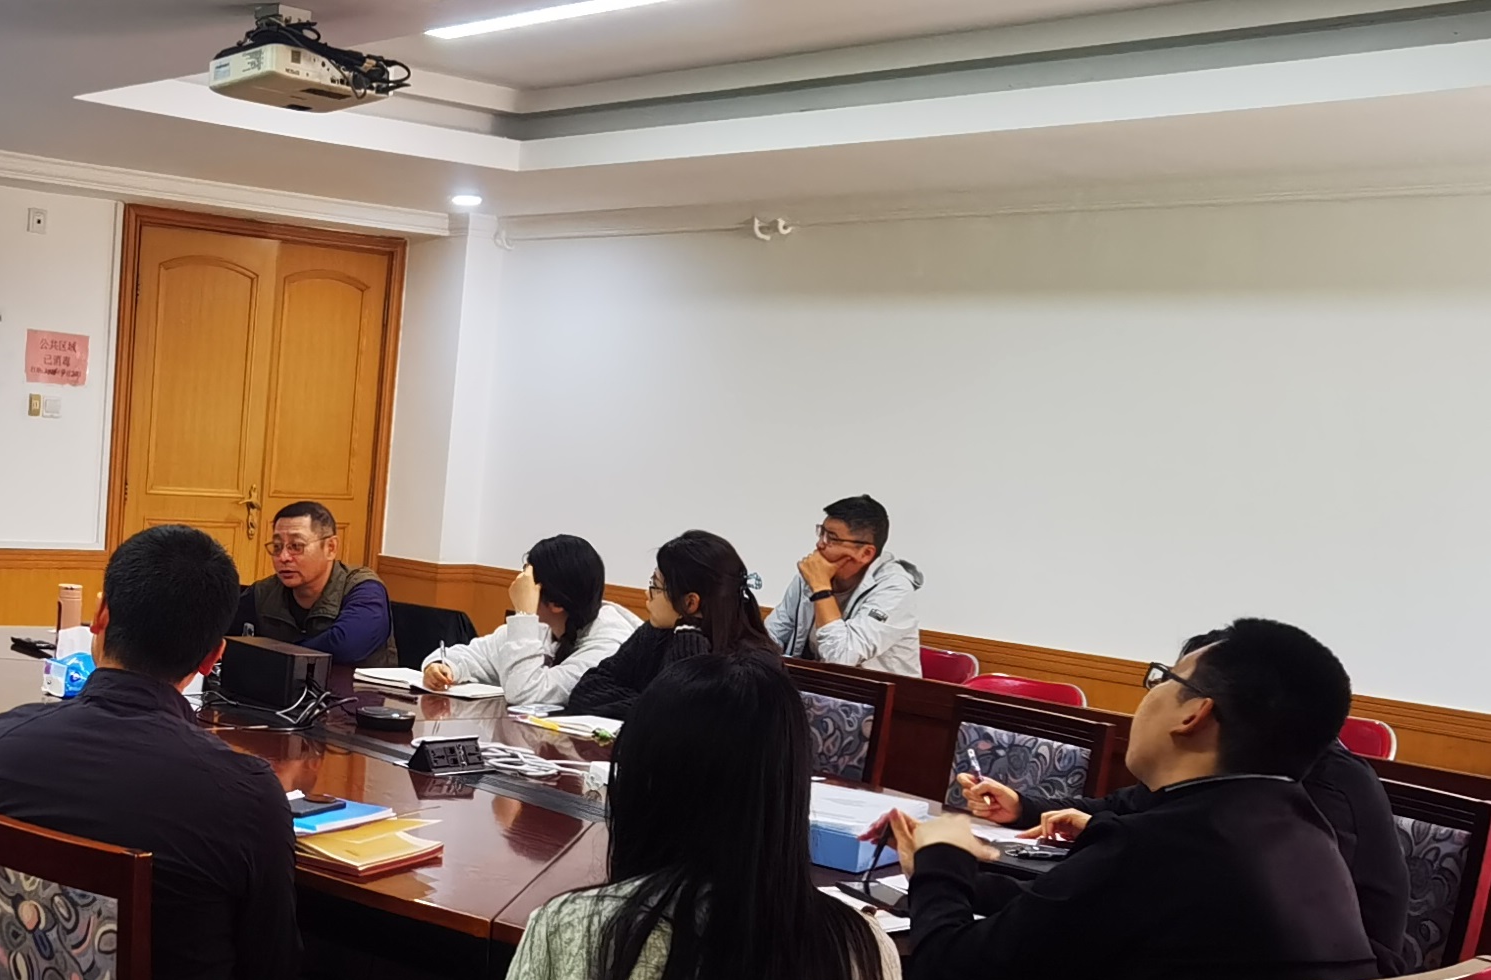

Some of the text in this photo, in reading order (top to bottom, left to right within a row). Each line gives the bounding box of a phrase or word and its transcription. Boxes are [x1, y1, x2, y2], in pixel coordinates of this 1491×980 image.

[39, 338, 77, 353] 公共区域
[43, 354, 71, 367] 已消毒
